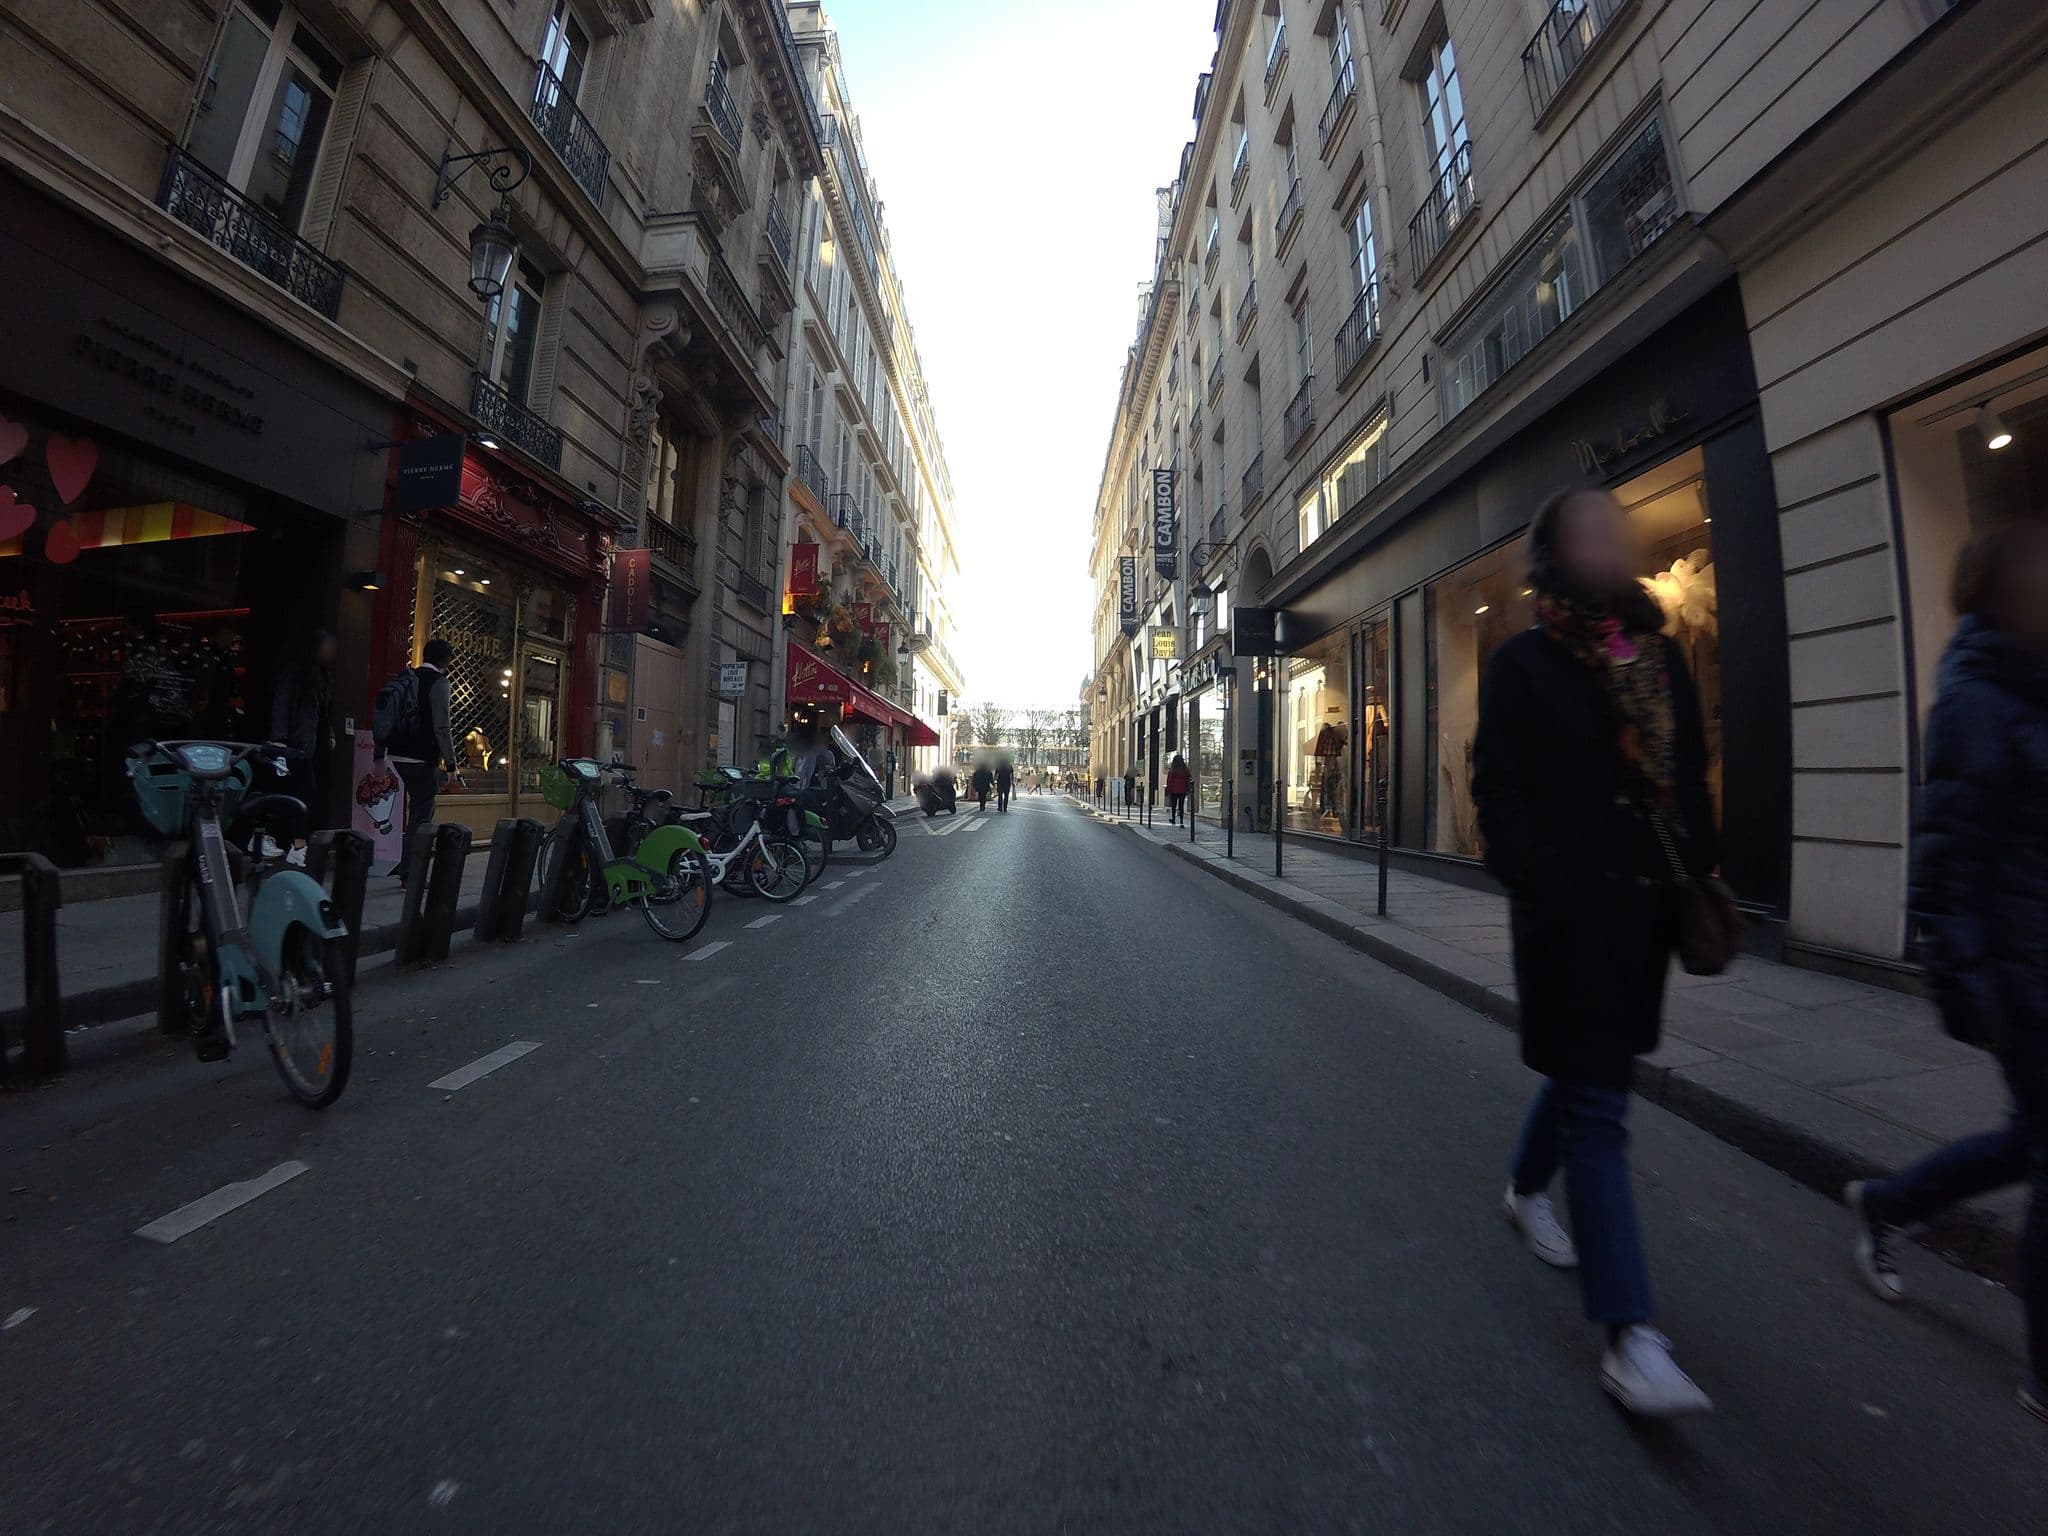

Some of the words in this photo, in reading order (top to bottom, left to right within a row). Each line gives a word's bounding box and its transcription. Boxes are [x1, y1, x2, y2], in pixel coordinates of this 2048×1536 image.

[1156, 471, 1173, 546] CAMBON
[1122, 558, 1135, 613] CAMBON
[1152, 628, 1171, 638] Jean
[1152, 637, 1176, 648] Louis
[1152, 647, 1176, 657] David
